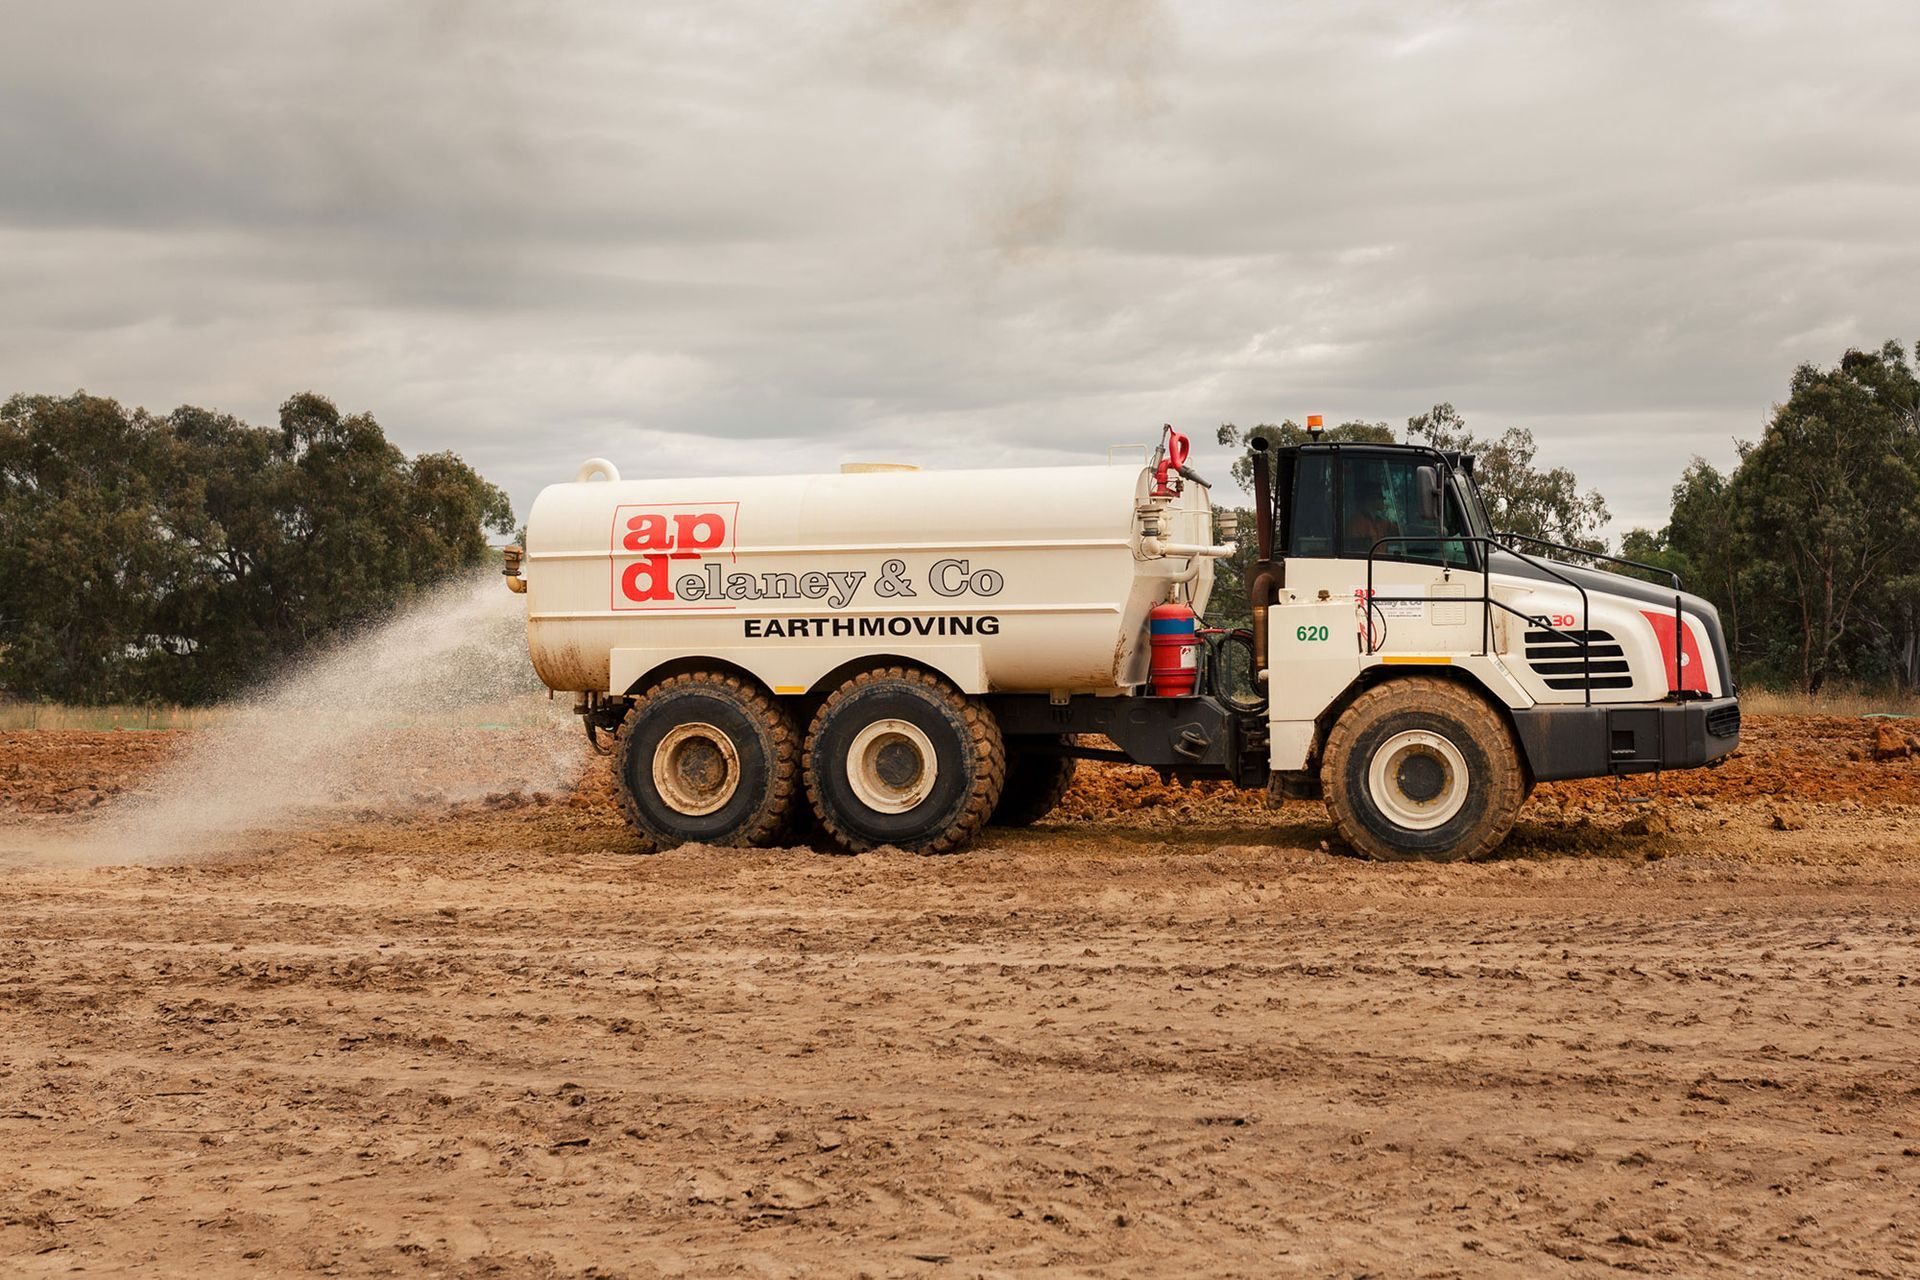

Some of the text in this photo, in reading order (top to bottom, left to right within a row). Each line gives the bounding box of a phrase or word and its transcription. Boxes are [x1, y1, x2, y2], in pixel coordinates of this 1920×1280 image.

[622, 512, 726, 559] ap
[621, 553, 1004, 610] delaney & Co
[743, 615, 1001, 638] EARTHMOVING
[1296, 625, 1329, 642] 620
